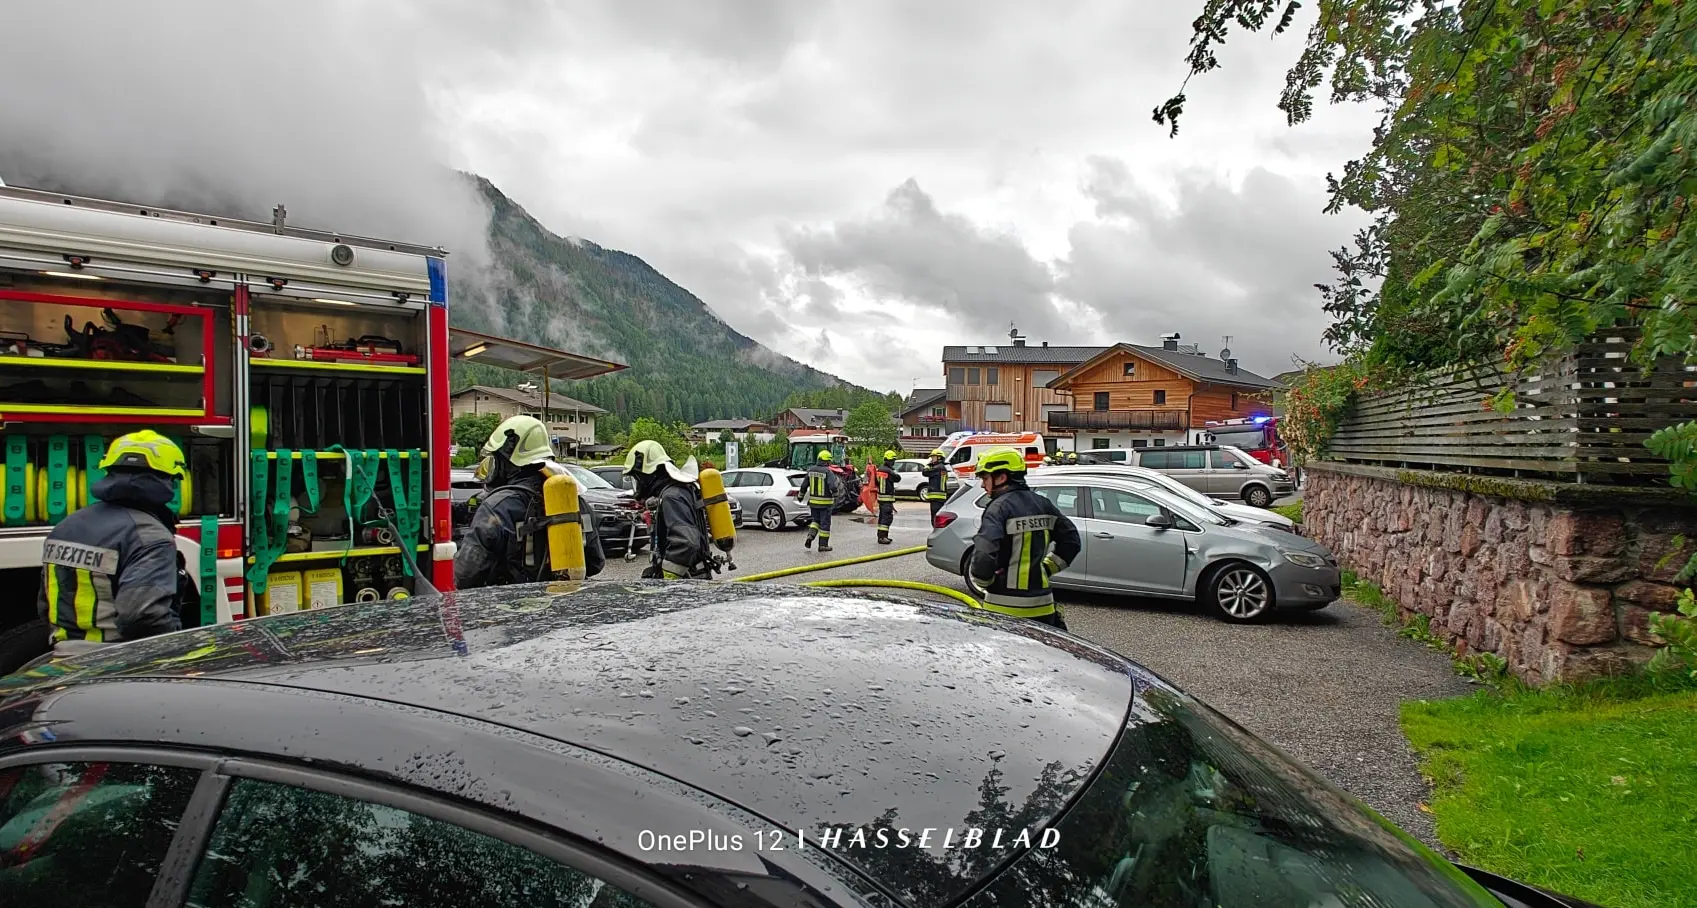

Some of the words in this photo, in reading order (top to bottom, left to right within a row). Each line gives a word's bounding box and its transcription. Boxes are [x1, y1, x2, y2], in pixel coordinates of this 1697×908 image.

[728, 445, 736, 463] P
[1016, 520, 1027, 530] FF
[55, 544, 103, 568] SEXTEN
